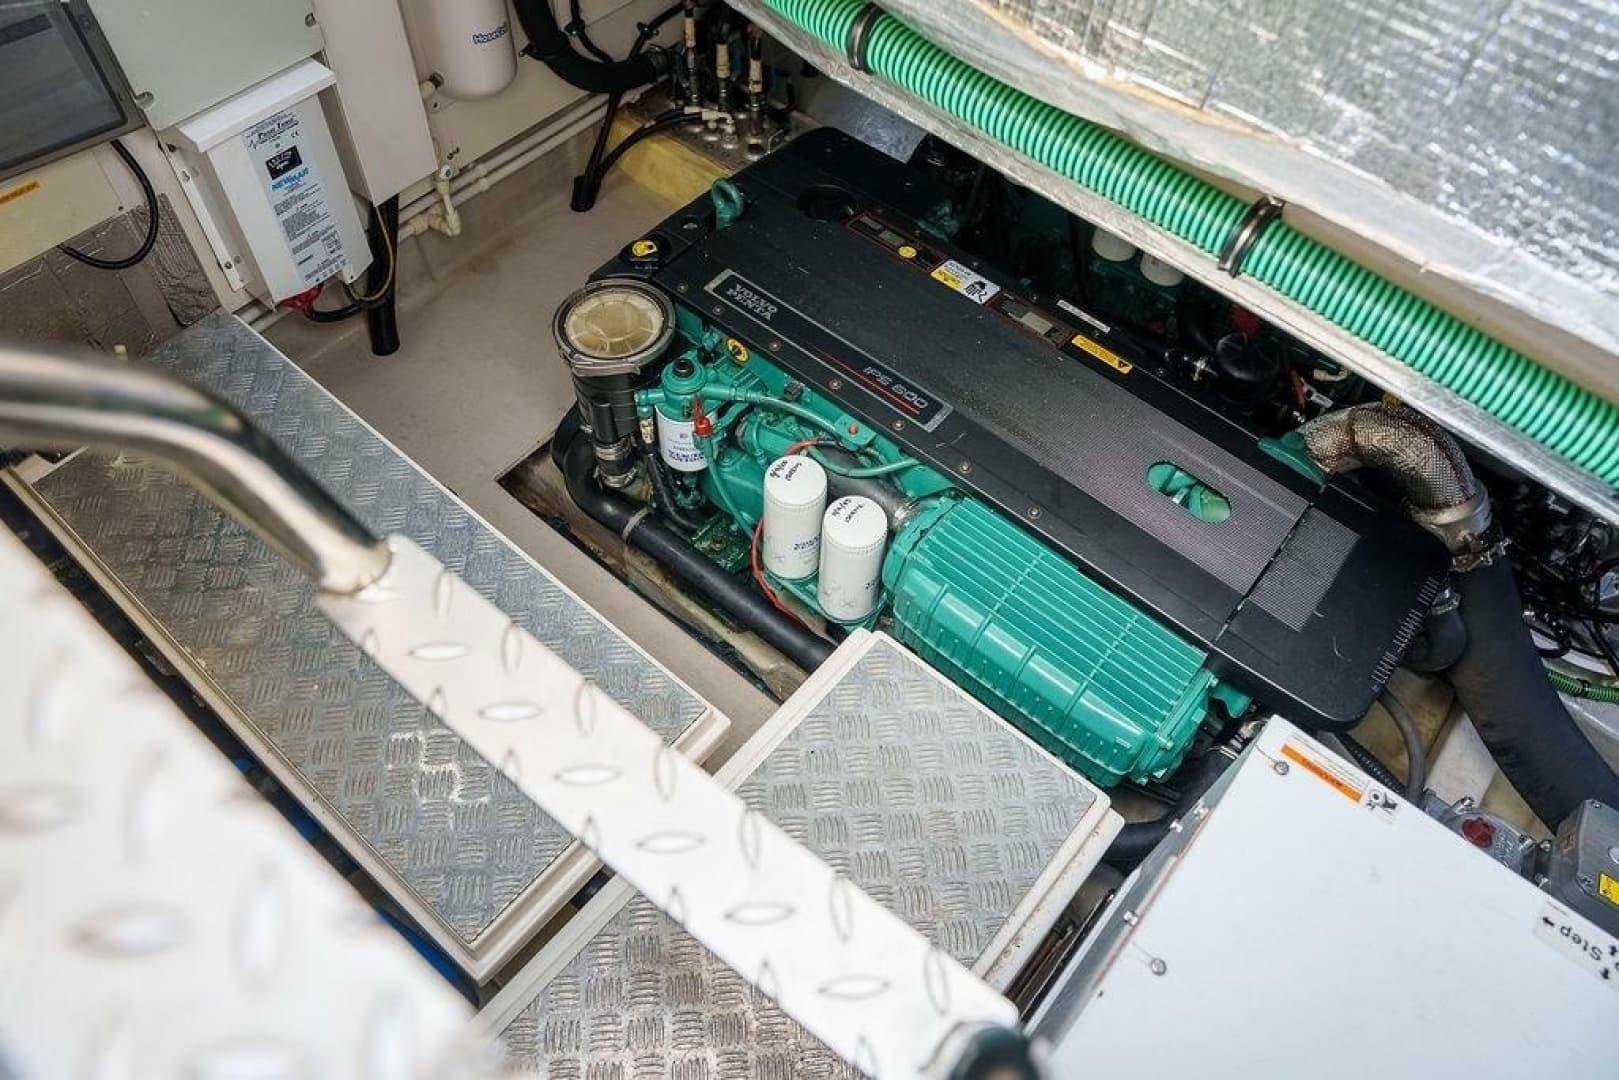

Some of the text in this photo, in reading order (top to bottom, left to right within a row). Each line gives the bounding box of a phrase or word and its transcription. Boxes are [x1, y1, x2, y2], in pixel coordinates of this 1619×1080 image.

[726, 288, 771, 321] PENTA
[735, 283, 778, 314] VOLVO
[863, 366, 929, 409] IPS 600
[1560, 926, 1603, 961] Step
